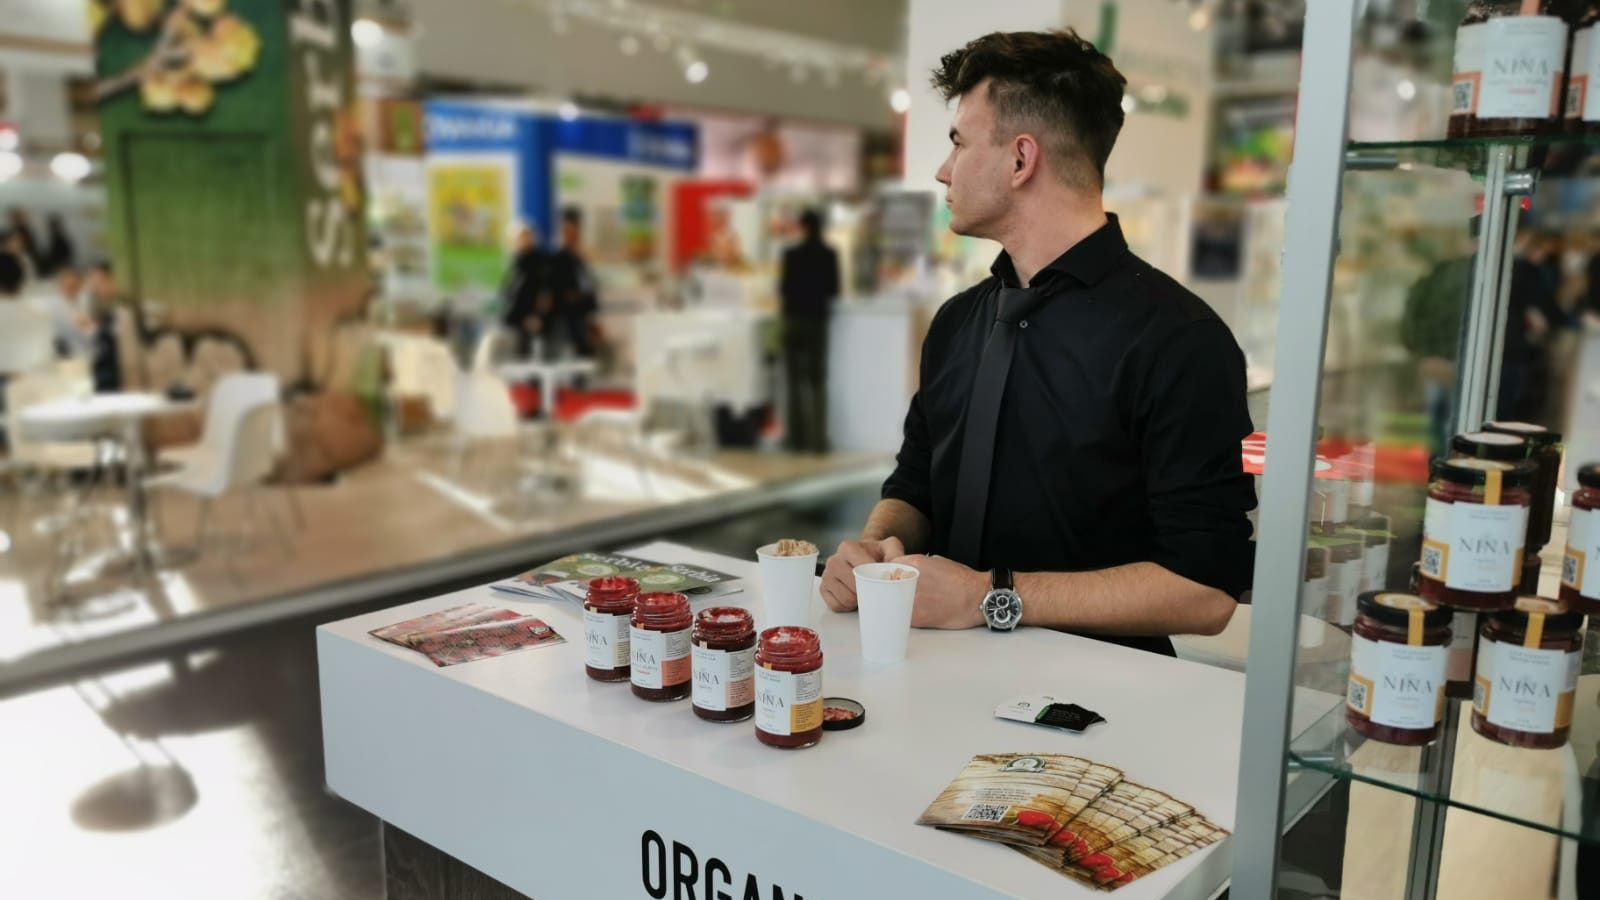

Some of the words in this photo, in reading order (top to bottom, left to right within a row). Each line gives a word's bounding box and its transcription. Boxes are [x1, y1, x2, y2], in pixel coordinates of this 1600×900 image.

[1459, 536, 1511, 556] NINA
[1383, 675, 1433, 693] NINA
[1500, 676, 1550, 698] NINA
[641, 829, 805, 900] ORG
